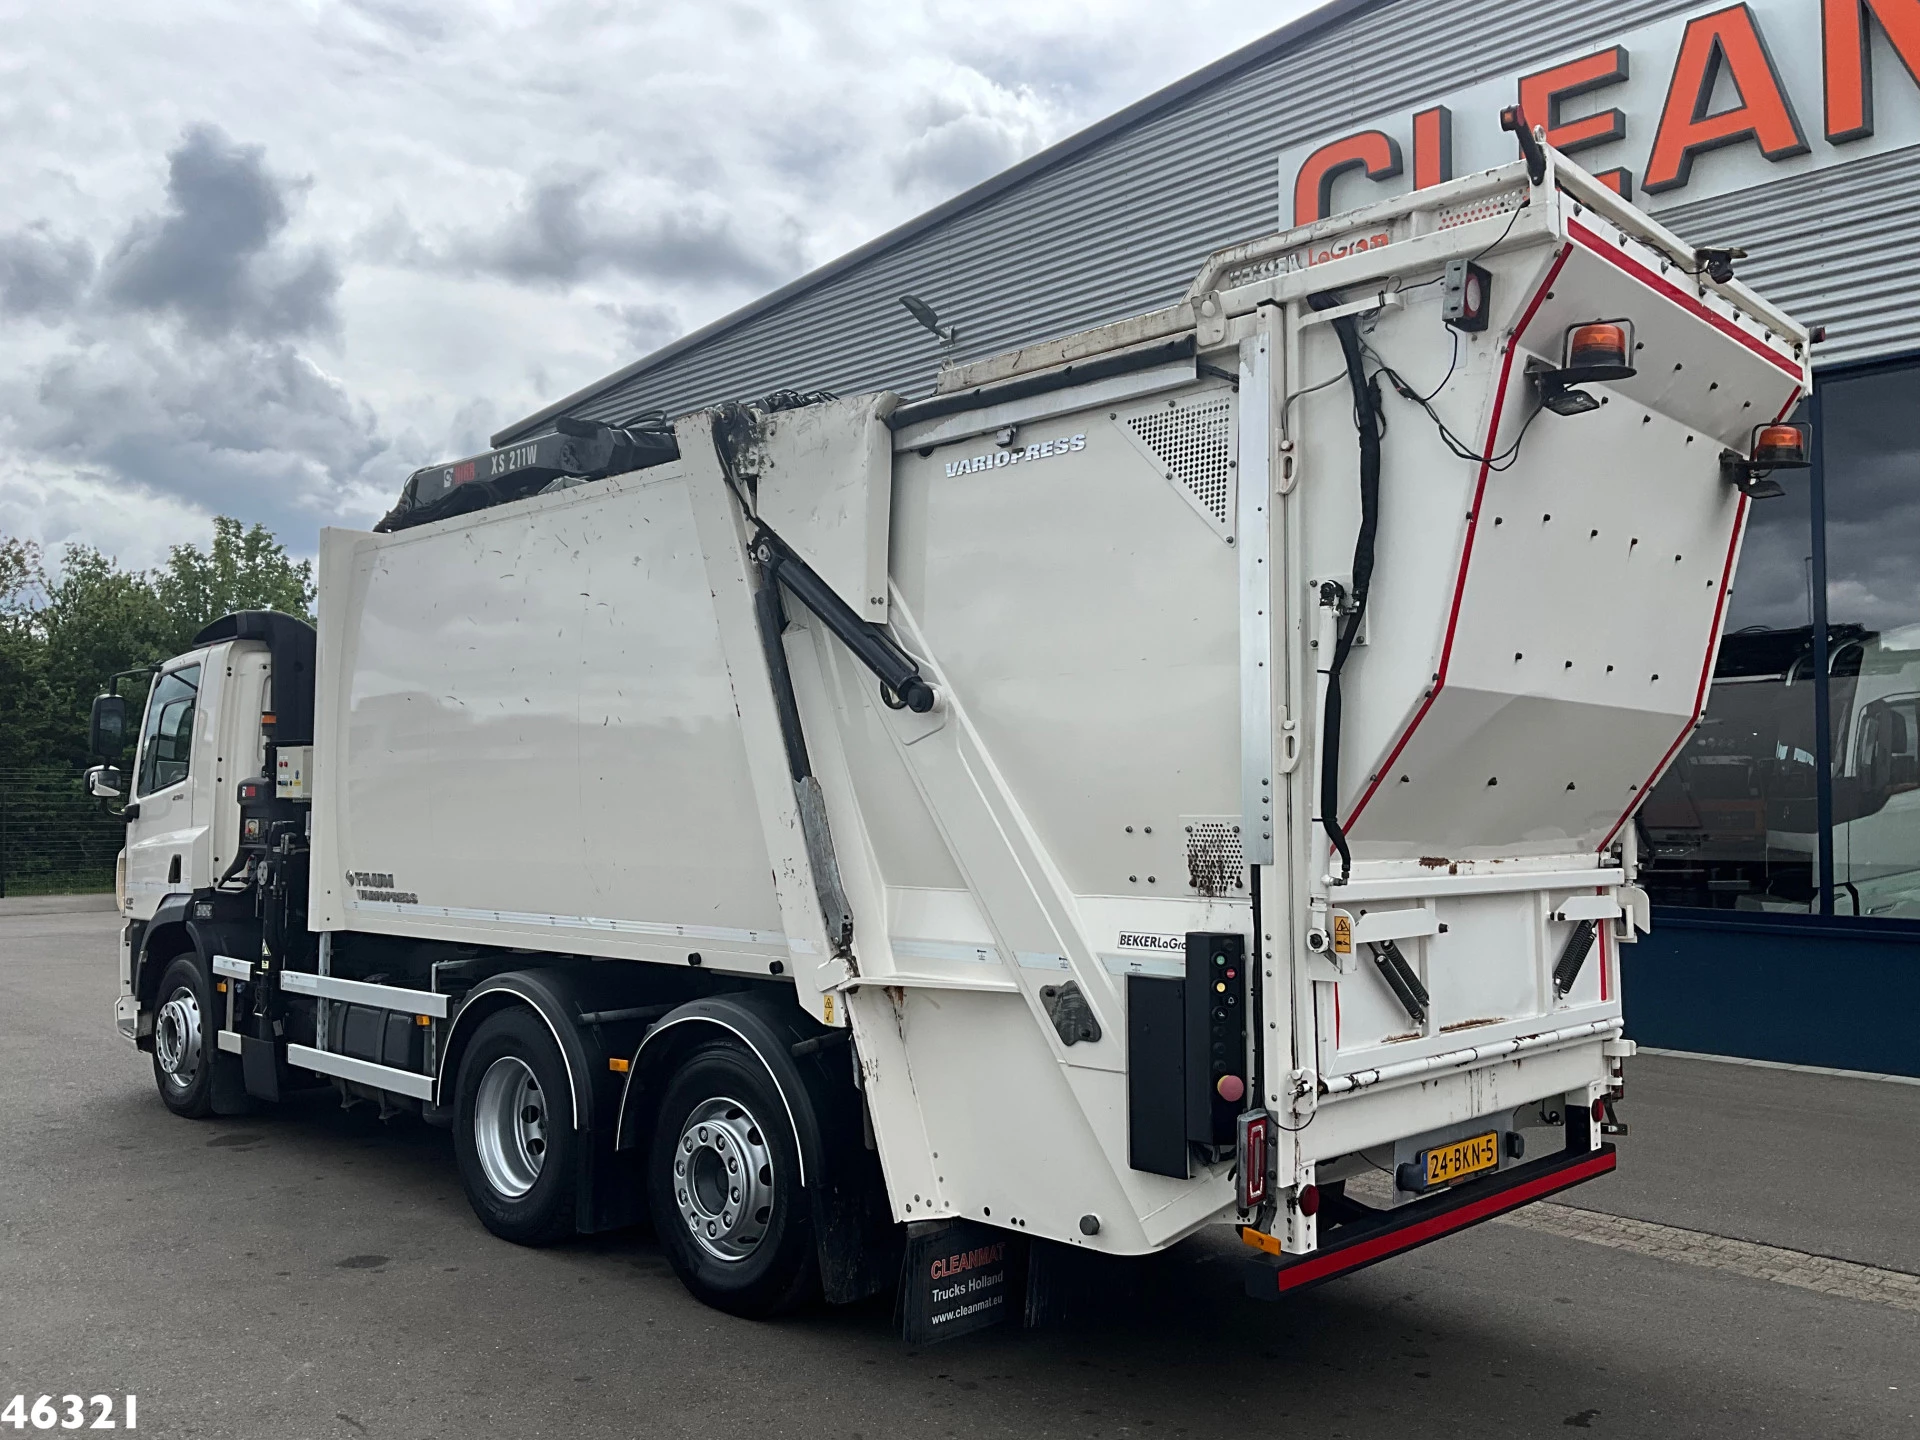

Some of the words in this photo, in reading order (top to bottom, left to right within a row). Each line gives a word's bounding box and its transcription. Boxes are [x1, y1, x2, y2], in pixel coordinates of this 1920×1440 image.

[491, 454, 505, 475] XS
[509, 444, 538, 470] 211W
[945, 433, 1087, 478] VARIOPRESS
[1430, 1138, 1494, 1179] 24-BKN-5
[931, 1242, 1006, 1280] CLEANMAT
[932, 1283, 966, 1303] Trucks
[968, 1270, 1004, 1292] Holland
[931, 1295, 1003, 1325] www.cleanmat.eu
